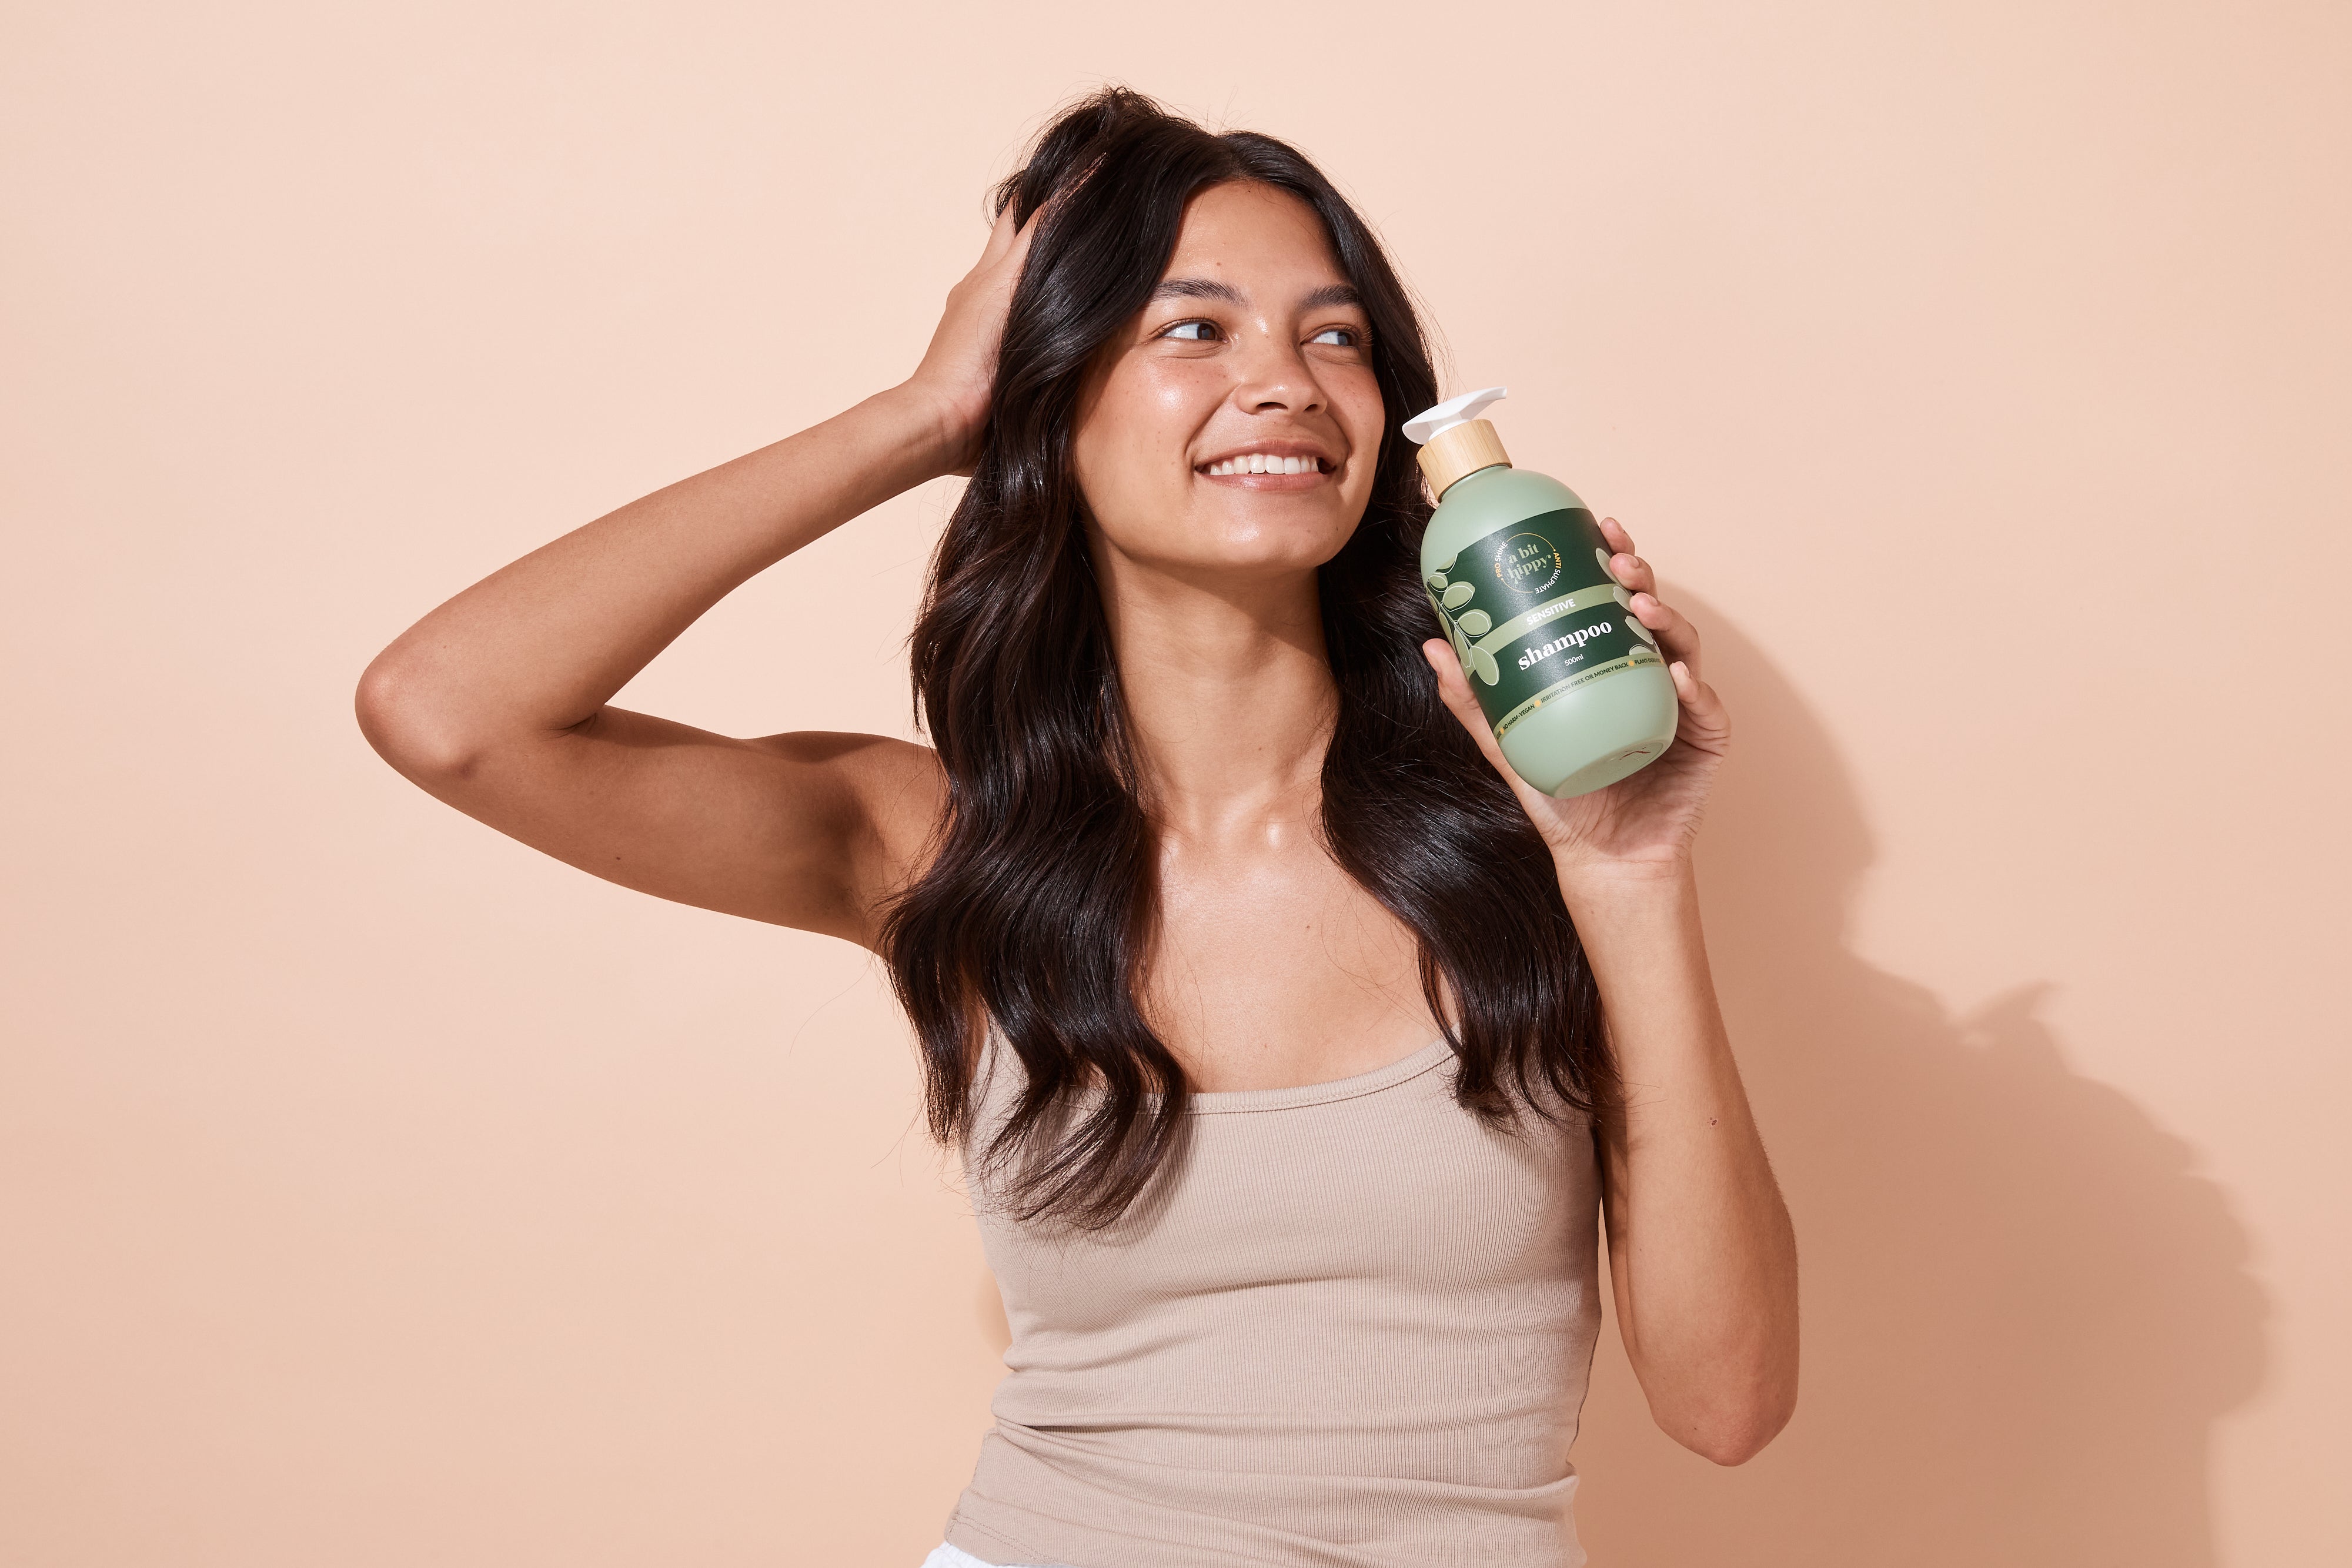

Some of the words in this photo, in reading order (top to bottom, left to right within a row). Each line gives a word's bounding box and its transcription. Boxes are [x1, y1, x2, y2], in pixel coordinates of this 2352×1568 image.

[1495, 541, 1508, 562] SHINE
[1509, 554, 1518, 564] a
[1518, 543, 1539, 559] bit
[1553, 552, 1562, 569] ANTI
[1494, 563, 1503, 578] PRO
[1507, 554, 1551, 584] hippy
[1534, 569, 1561, 594] SULPHATE
[1526, 599, 1576, 625] SENSITIVE
[1518, 621, 1612, 671] shampoo
[1564, 653, 1584, 666] 500ml
[1541, 684, 1571, 703] IRRITATION
[1571, 678, 1585, 687] FREE
[1593, 666, 1614, 677] MONEY
[1614, 662, 1629, 670] BACK
[1507, 715, 1519, 727] HARM
[1519, 704, 1535, 717] VEGAN
